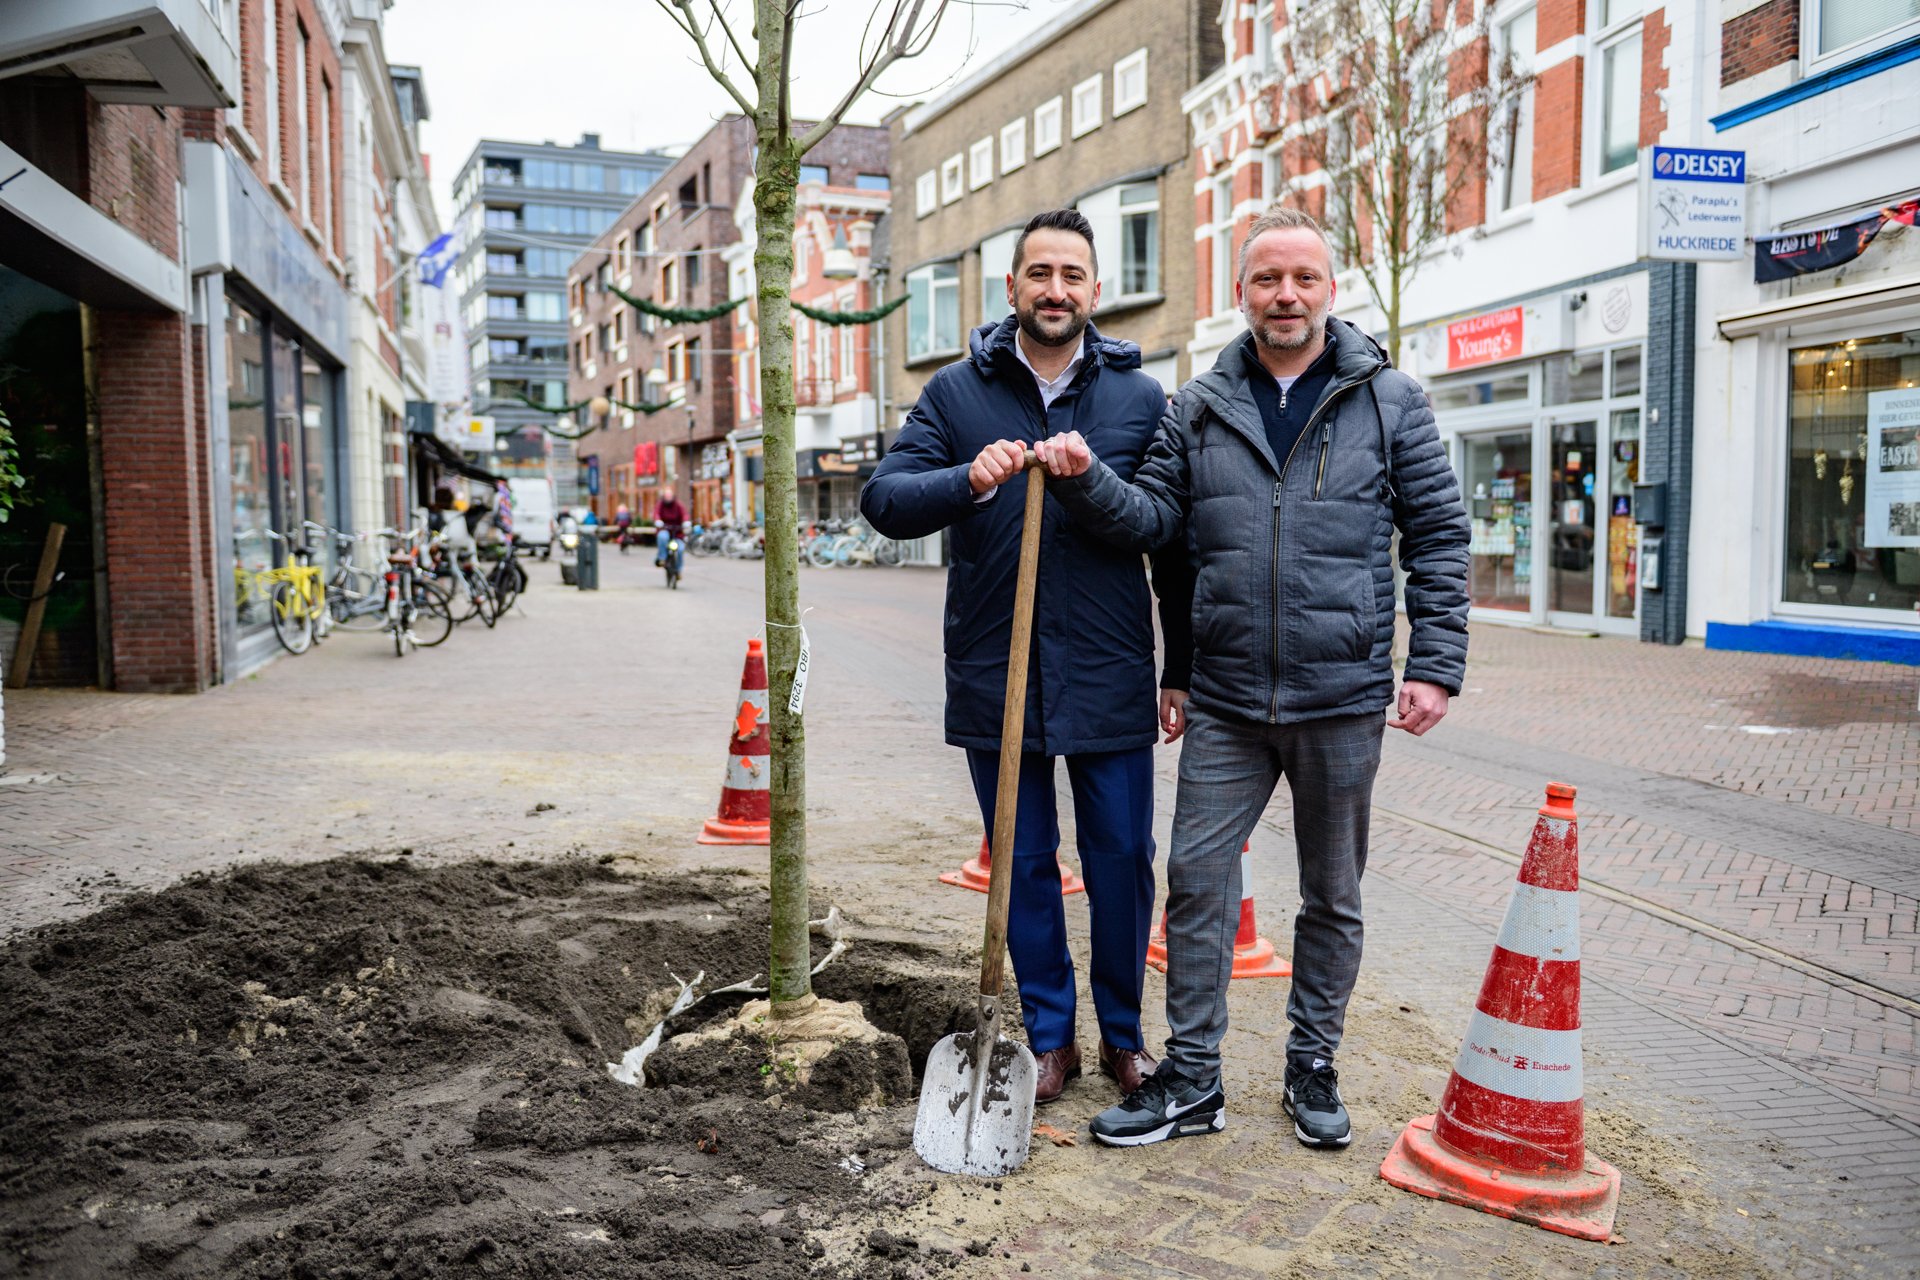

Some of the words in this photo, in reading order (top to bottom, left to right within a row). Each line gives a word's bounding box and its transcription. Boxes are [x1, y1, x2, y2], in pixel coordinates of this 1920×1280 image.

[1673, 153, 1742, 177] DELSEY
[1688, 212, 1742, 222] Lederwaren
[1658, 235, 1737, 251] HUCKRIEDE
[1456, 326, 1512, 360] Young's
[791, 679, 803, 709] 3294
[1532, 1061, 1571, 1071] Enschede
